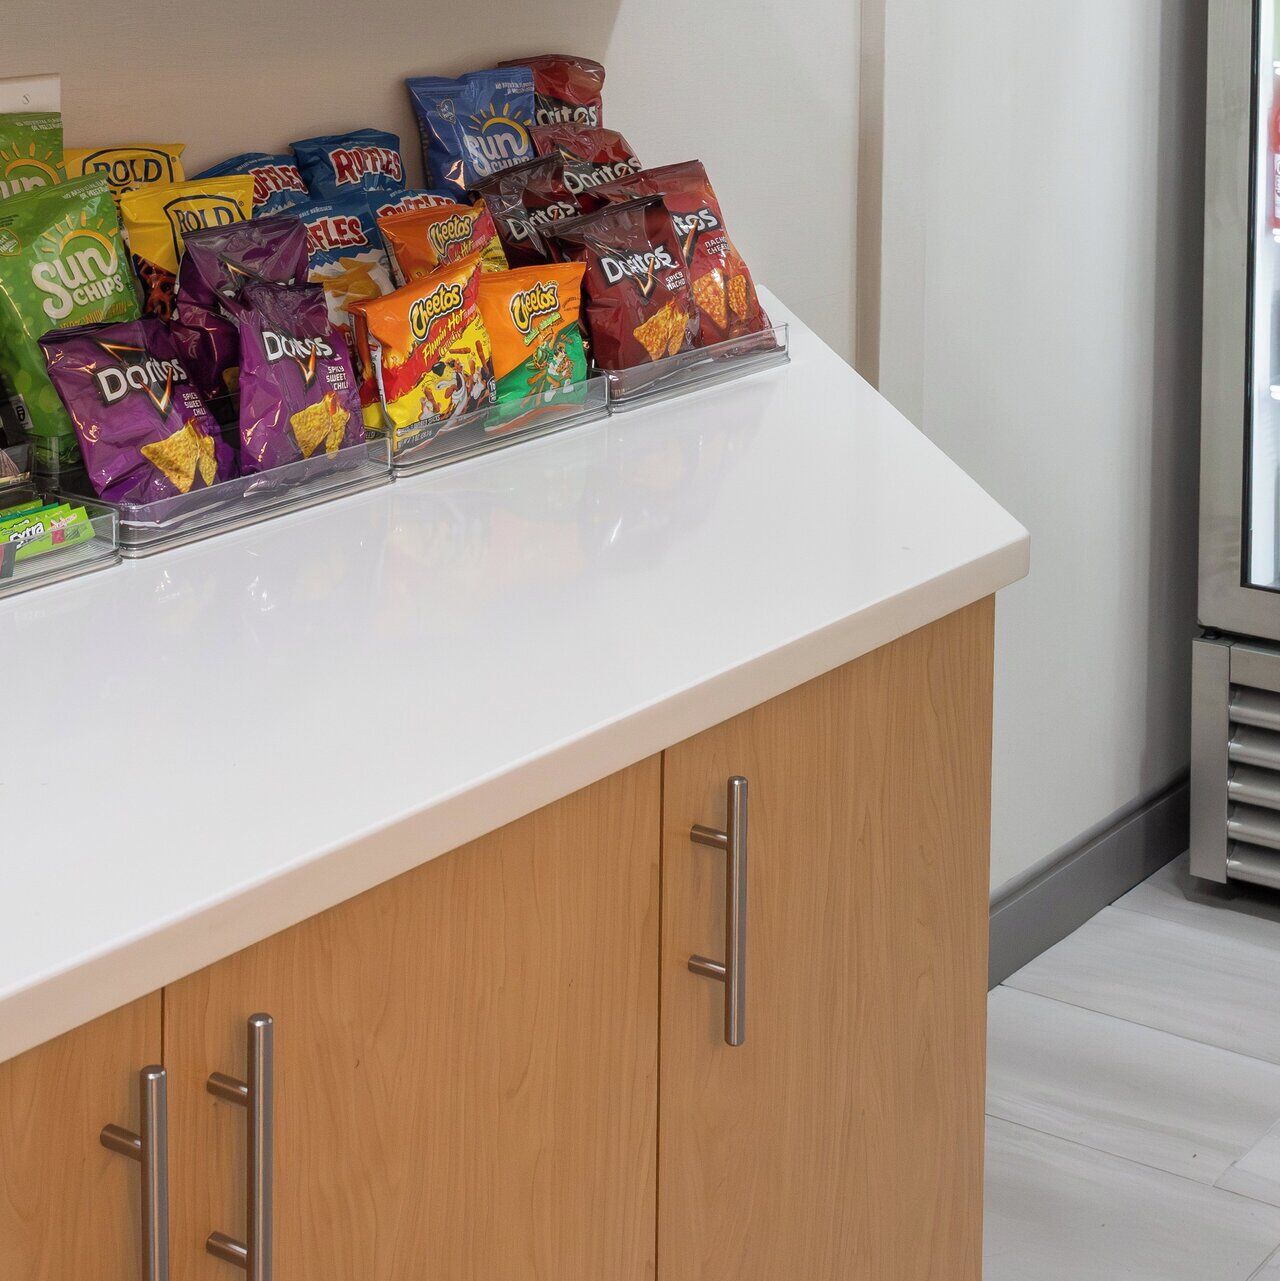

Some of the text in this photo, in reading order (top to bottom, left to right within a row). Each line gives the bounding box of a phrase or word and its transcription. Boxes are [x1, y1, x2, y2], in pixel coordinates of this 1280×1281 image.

[330, 148, 401, 184] RUFFLES
[32, 247, 119, 320] Sun
[71, 274, 124, 307] CHIPS
[410, 284, 463, 339] Cheetos
[510, 282, 559, 334] Cheetos
[263, 331, 332, 361] Doritos
[96, 358, 187, 402] Doritos
[326, 374, 347, 383] SWEET
[333, 381, 349, 390] CHILI
